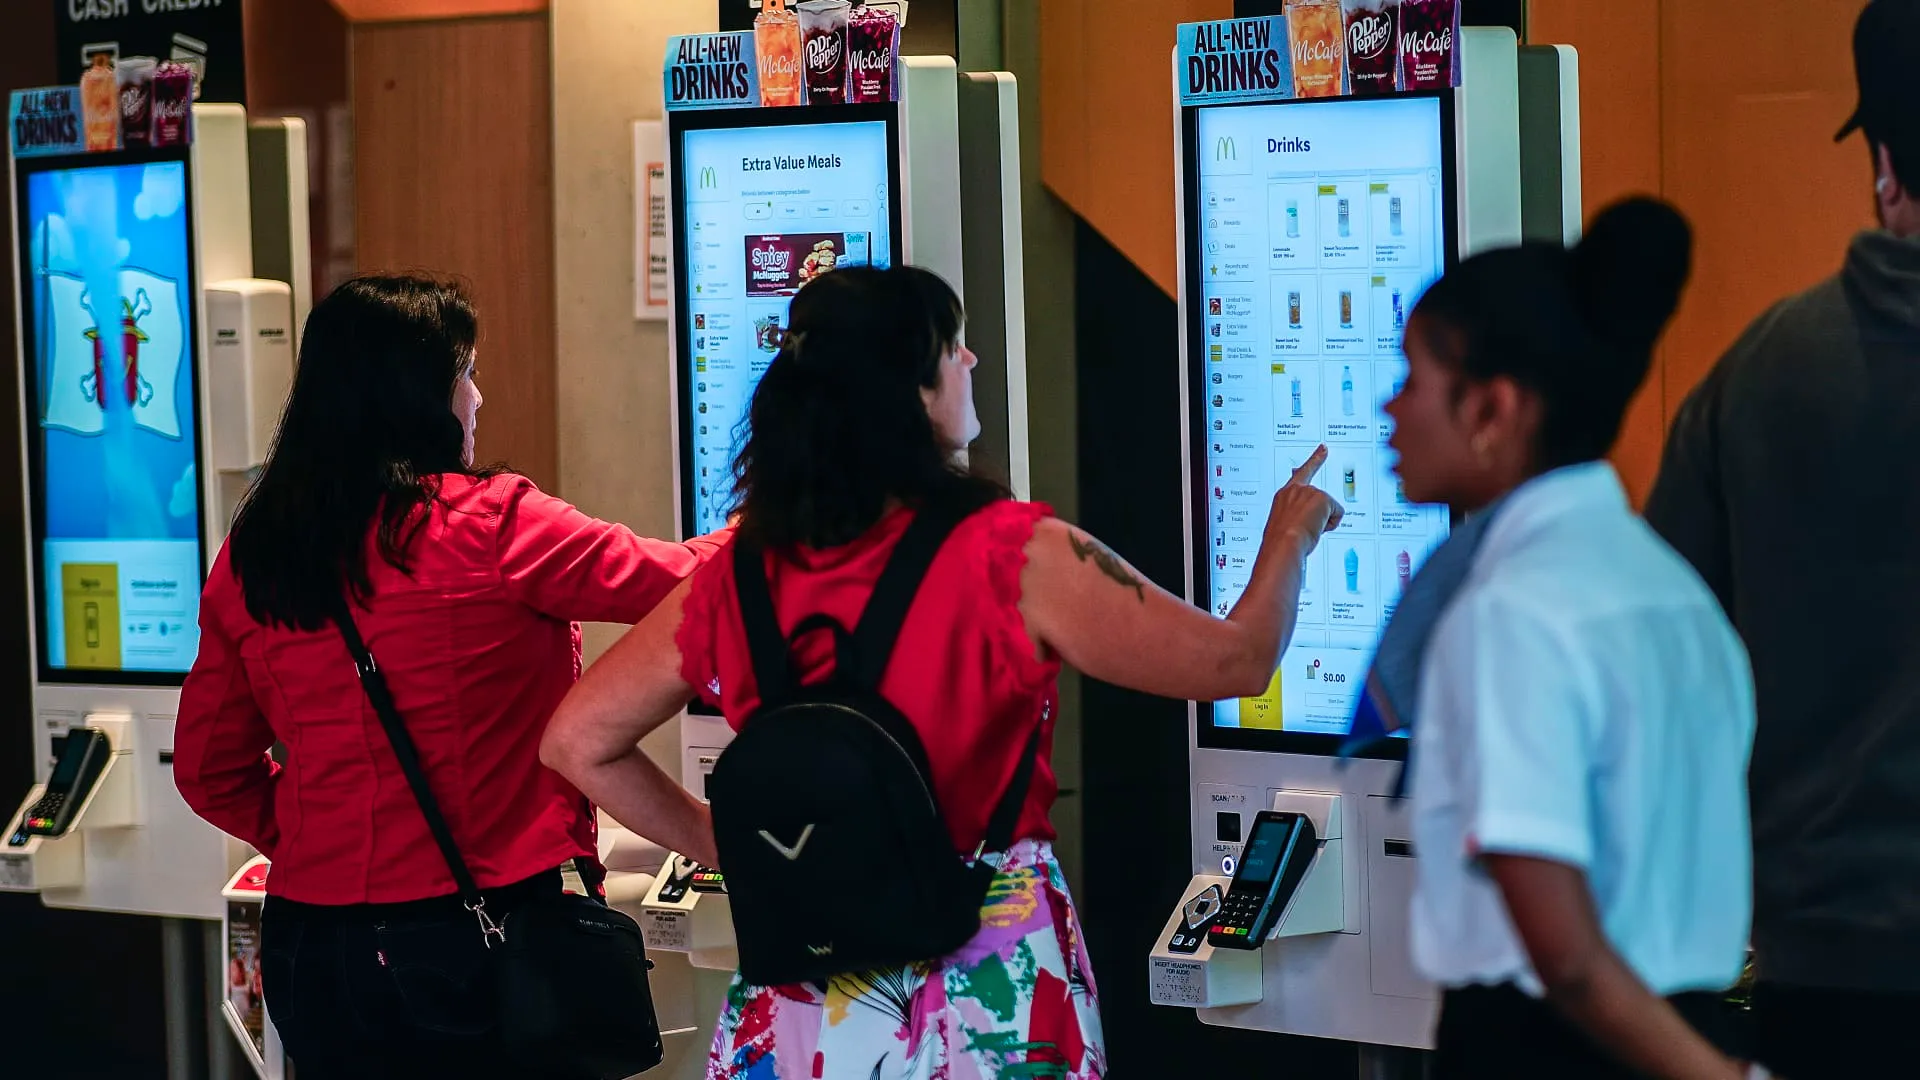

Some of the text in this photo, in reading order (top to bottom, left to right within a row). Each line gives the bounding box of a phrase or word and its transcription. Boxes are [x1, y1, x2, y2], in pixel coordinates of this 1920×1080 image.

[1195, 20, 1271, 53] ALL-NEW
[1352, 18, 1390, 54] Pepper
[1364, 16, 1380, 35] Dr
[677, 36, 742, 64] ALL-NEW
[809, 39, 840, 69] Pepper
[817, 35, 832, 50] Dr
[1293, 38, 1344, 66] McCafé
[1400, 27, 1452, 58] McCafé
[760, 54, 800, 78] McCafé
[849, 47, 890, 75] McCafé
[1188, 49, 1280, 93] DRINKS
[671, 62, 749, 101] DRINKS
[20, 90, 71, 114] ALL-NEW
[16, 113, 77, 147] DRINKS
[1267, 137, 1311, 153] Drinks
[742, 153, 841, 171] Extra Value Meals
[752, 246, 789, 271] Spicy
[753, 271, 789, 281] McNuggets
[1323, 673, 1346, 683] $0.00
